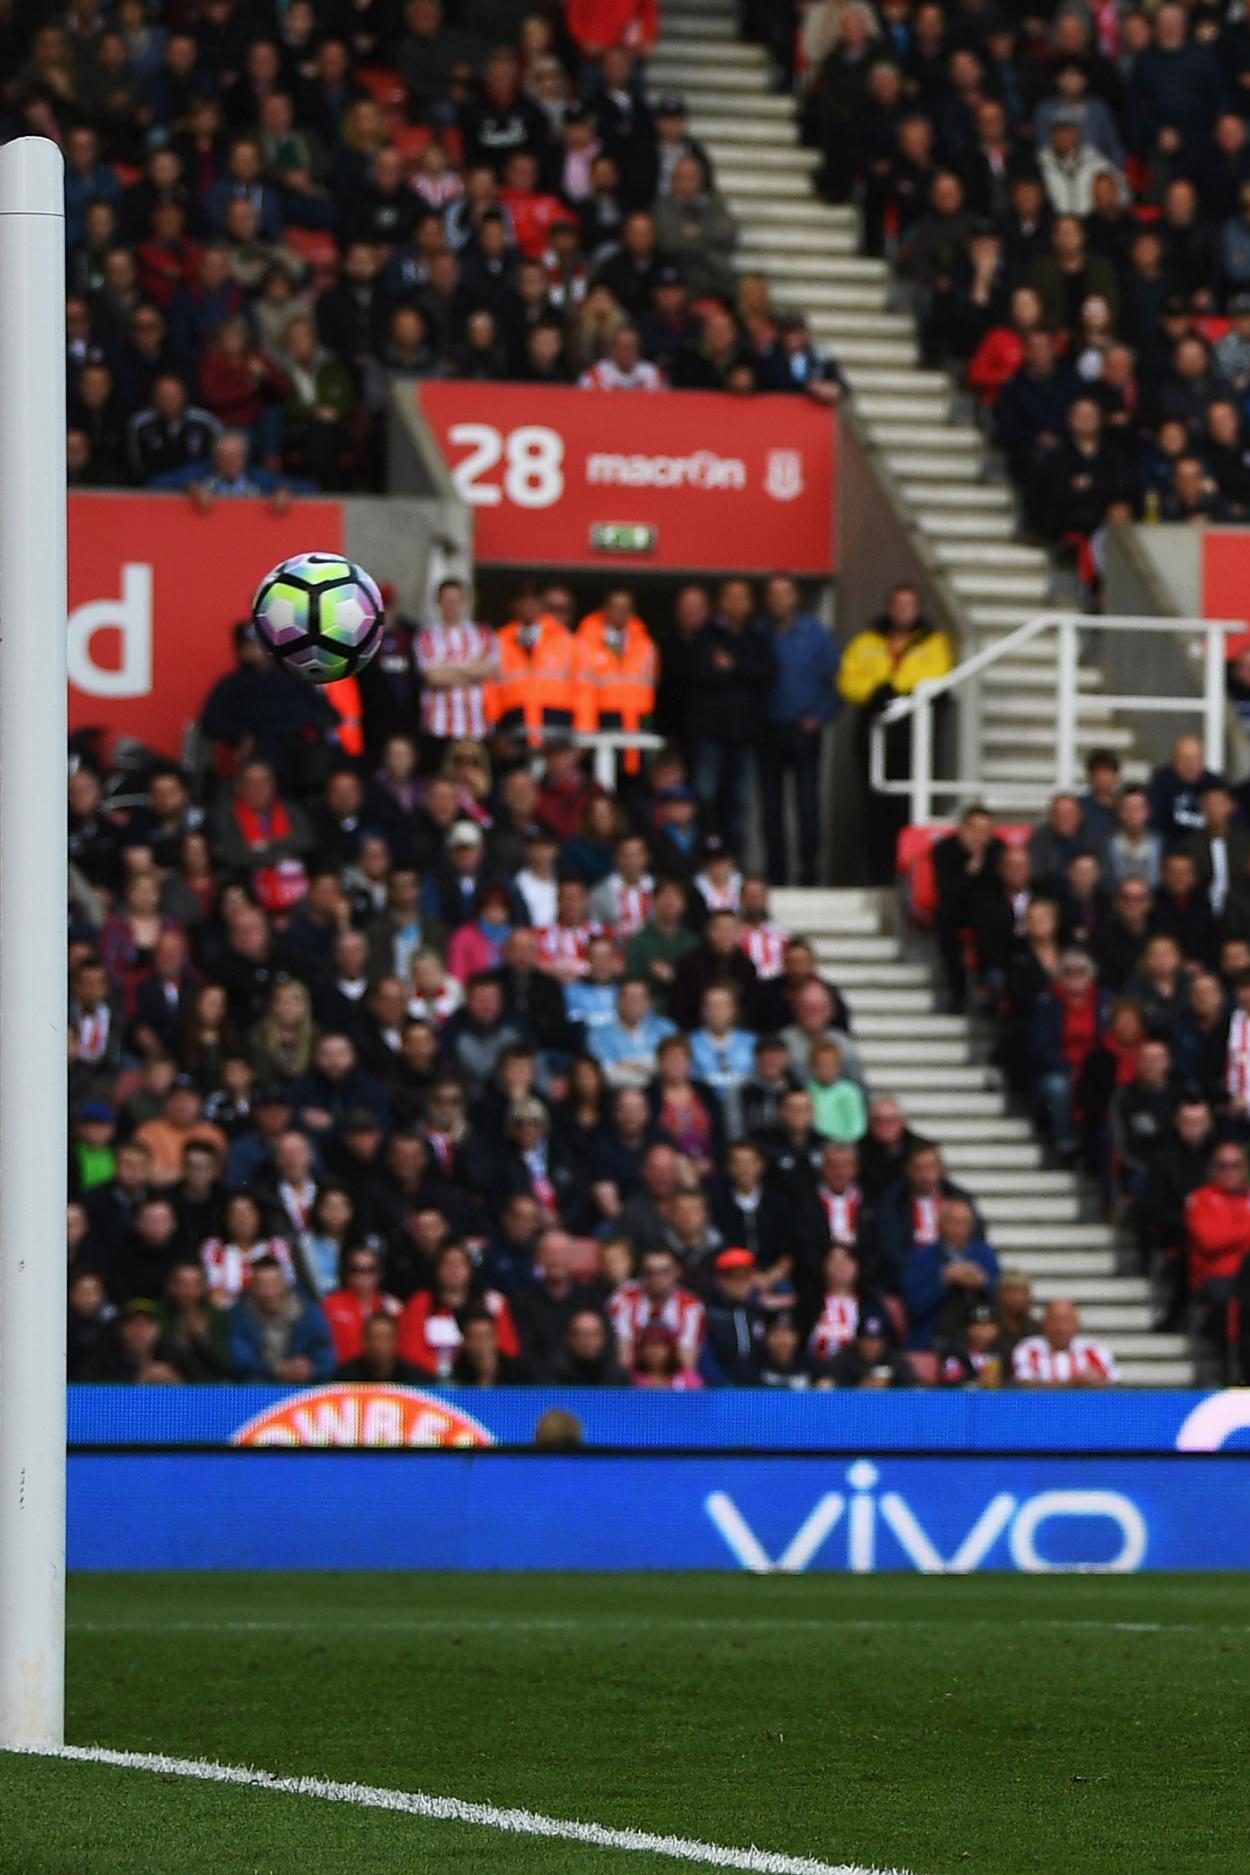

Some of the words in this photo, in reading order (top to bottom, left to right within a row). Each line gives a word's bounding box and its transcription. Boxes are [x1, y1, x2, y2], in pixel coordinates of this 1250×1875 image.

[449, 424, 565, 508] 28
[586, 451, 746, 490] macron
[705, 1459, 1148, 1575] vivo
